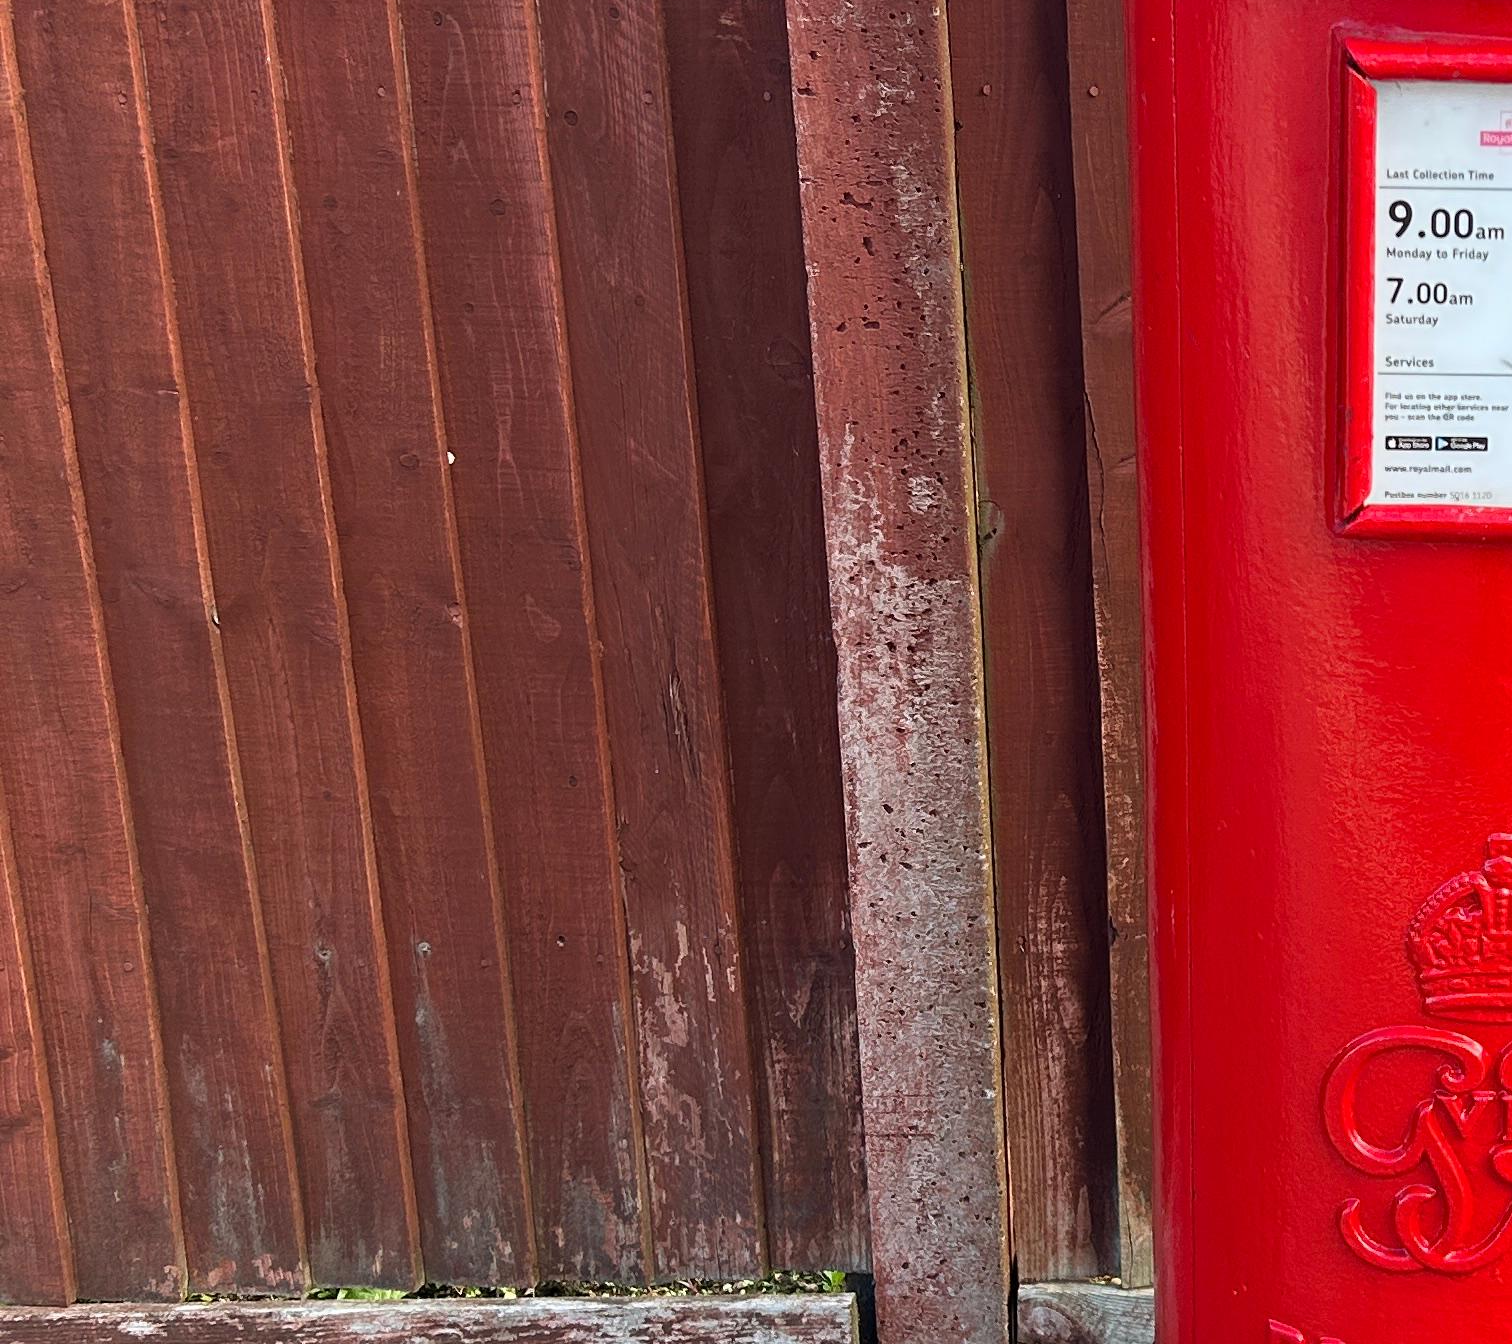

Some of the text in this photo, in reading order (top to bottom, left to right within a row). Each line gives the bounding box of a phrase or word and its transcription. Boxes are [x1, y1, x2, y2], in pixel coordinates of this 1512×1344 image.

[1482, 133, 1512, 145] Royal
[1386, 169, 1495, 181] Last Collection Time
[1388, 200, 1505, 240] 9.00am
[1386, 248, 1489, 262] Monday to Friday
[1386, 277, 1474, 306] 7.00am
[1385, 313, 1439, 327] Saturday
[1385, 356, 1434, 368] Services
[1385, 392, 1402, 400] Find
[1400, 403, 1431, 411] locating
[1443, 413, 1454, 421] QR
[1384, 465, 1472, 475] www.royalmail.com
[1385, 491, 1414, 499] Postbox
[1417, 491, 1447, 499] number
